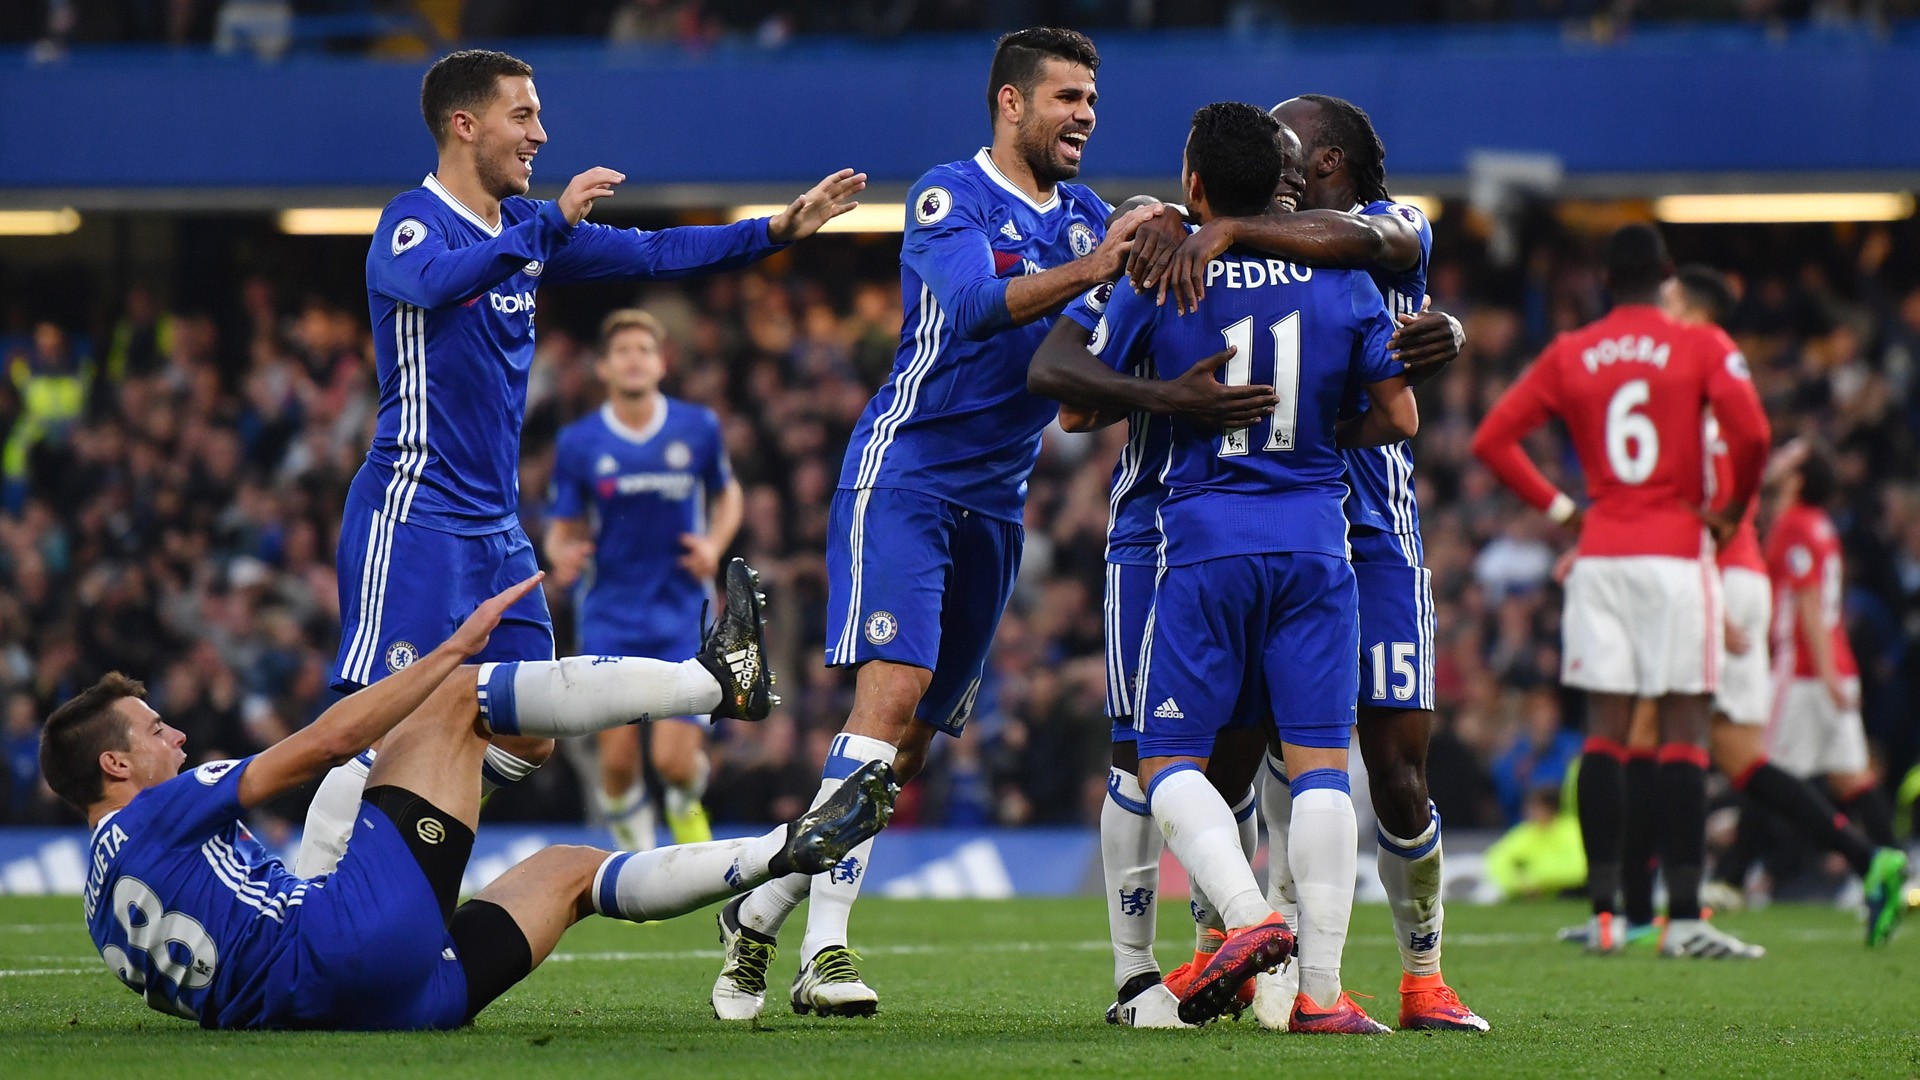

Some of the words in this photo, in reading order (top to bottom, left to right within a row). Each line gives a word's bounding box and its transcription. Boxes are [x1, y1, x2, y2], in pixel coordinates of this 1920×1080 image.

[1206, 259, 1313, 289] PEDRO
[1581, 334, 1671, 374] POGBA
[1217, 309, 1300, 458] 11
[1605, 377, 1660, 485] 6
[741, 643, 758, 690] adidas
[1370, 641, 1416, 700] 15
[1153, 710, 1185, 719] adidas
